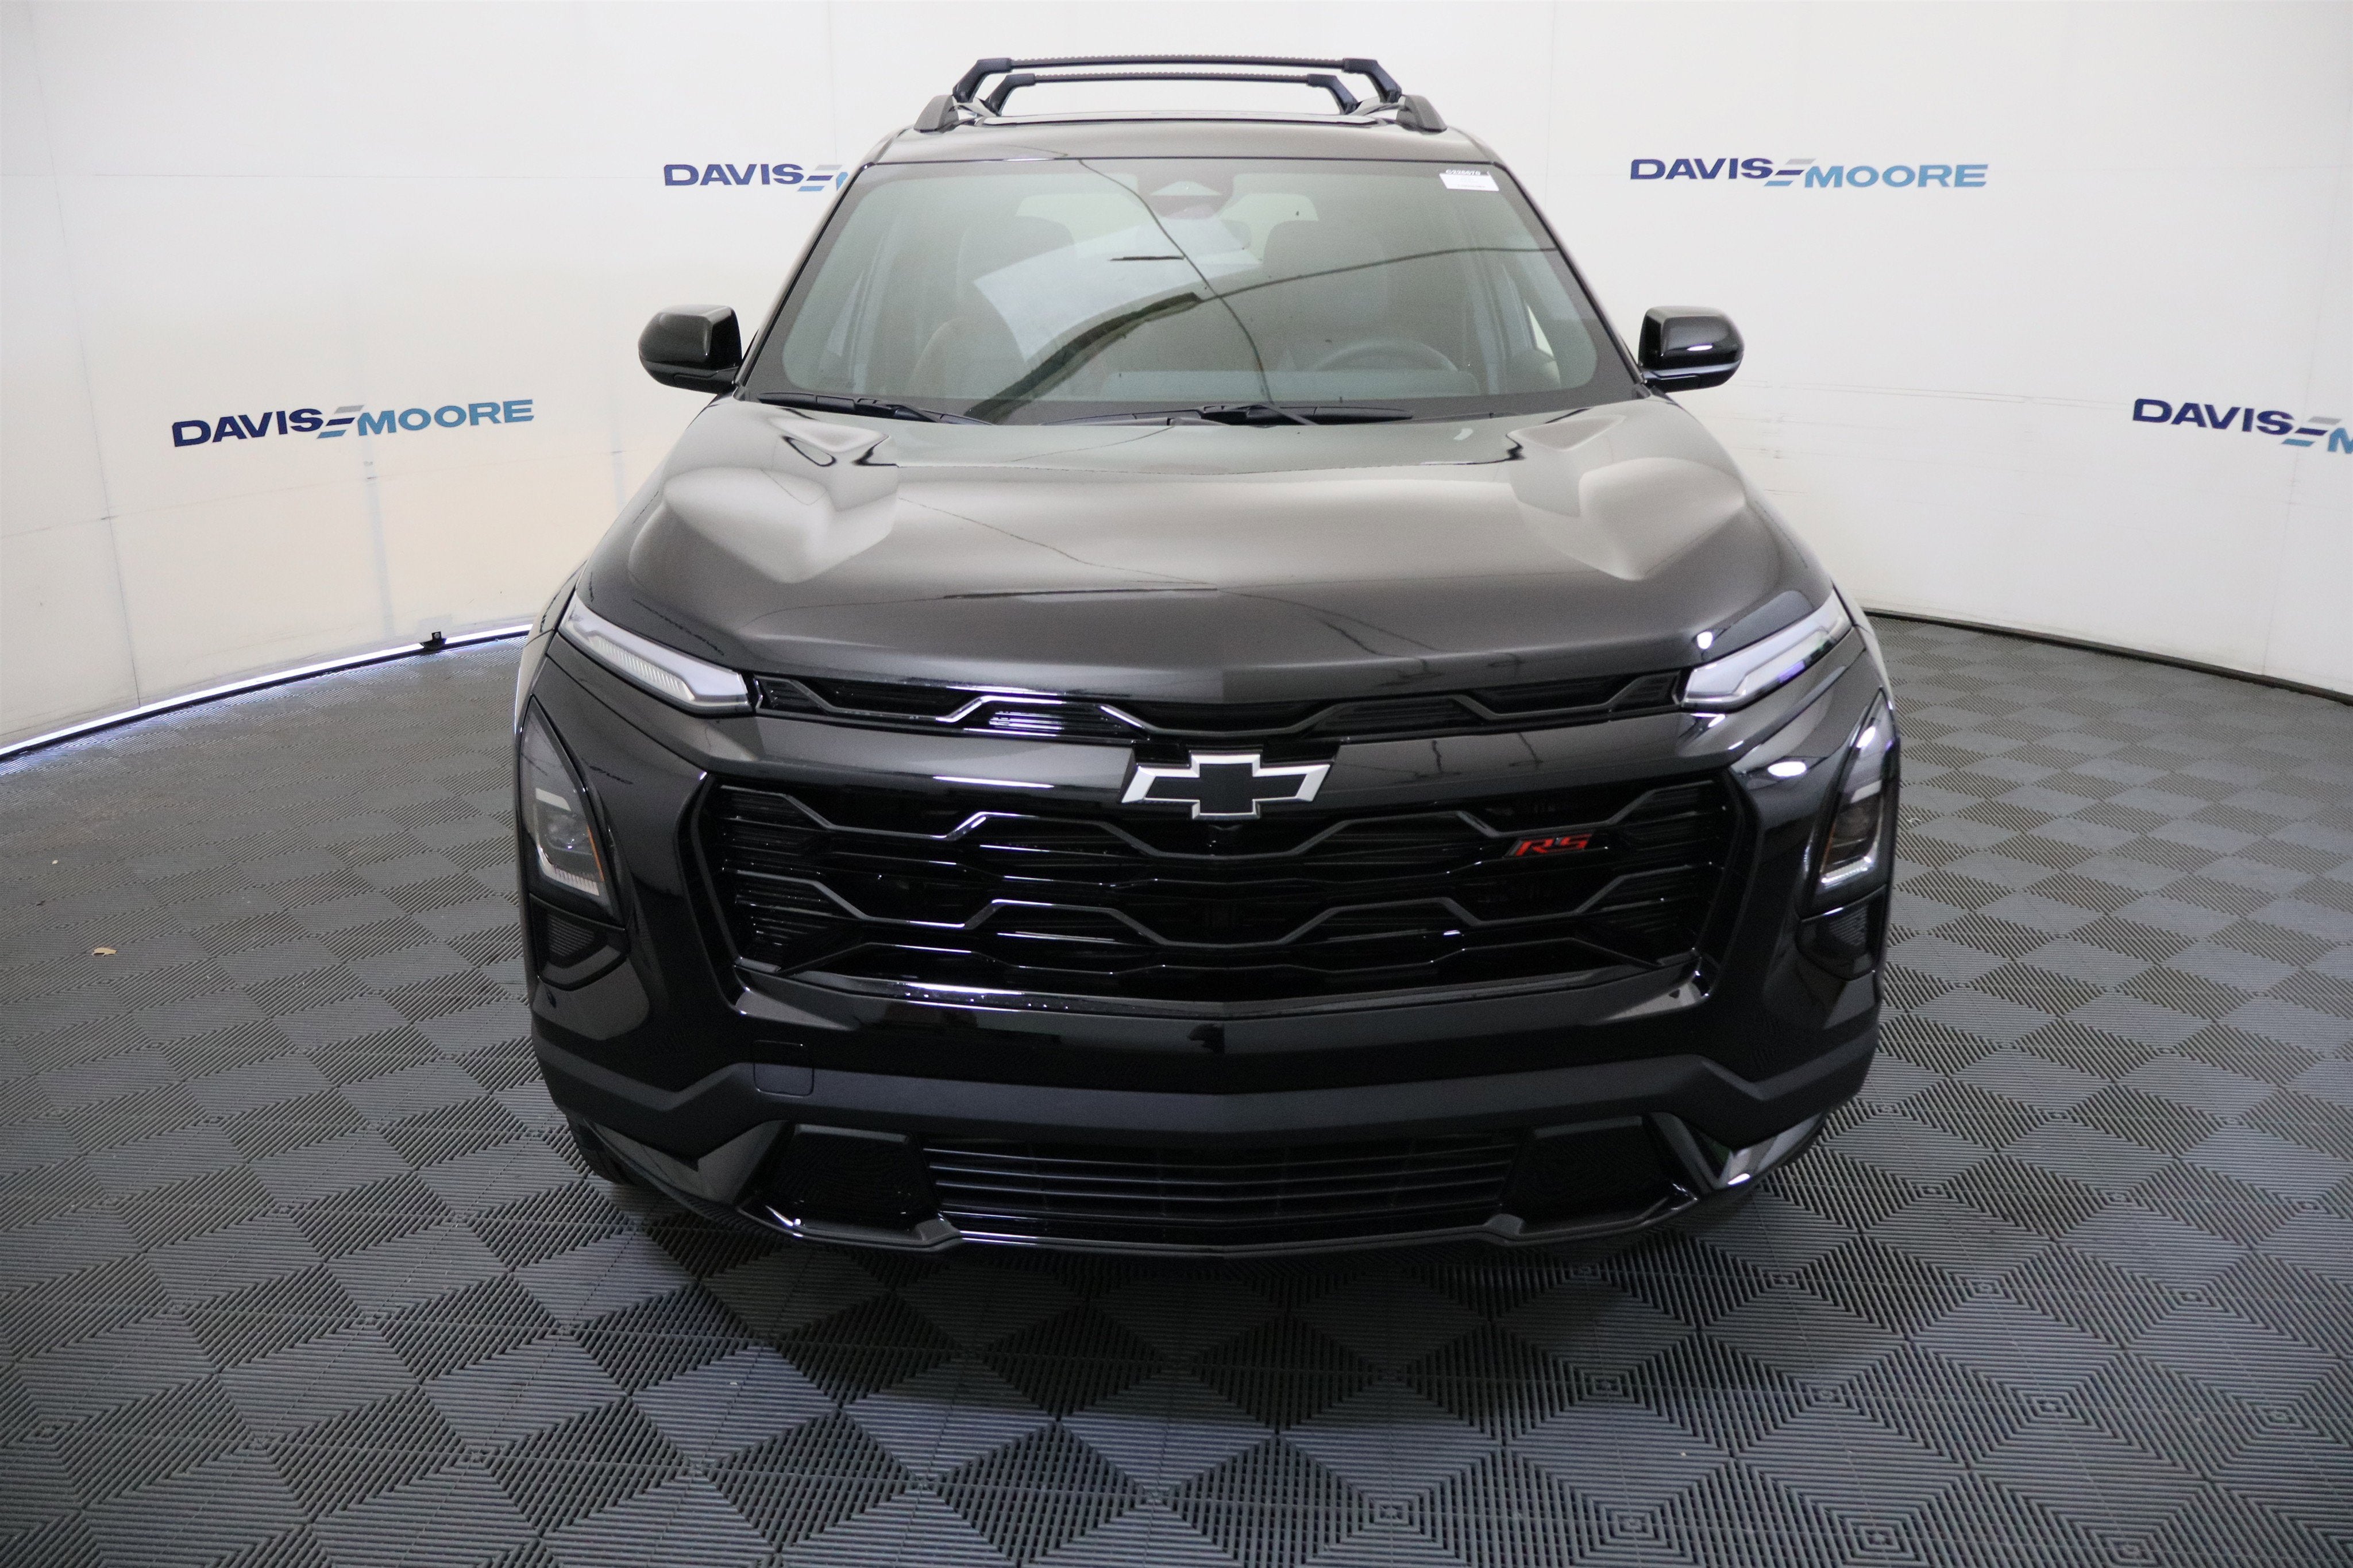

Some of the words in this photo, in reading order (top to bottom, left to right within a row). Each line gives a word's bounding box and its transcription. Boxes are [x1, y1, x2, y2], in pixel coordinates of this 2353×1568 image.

[664, 164, 804, 186] DAVIS
[1630, 158, 1774, 179] DAVIS
[1804, 164, 1989, 188] MOORE
[171, 408, 325, 447] DAVIS
[357, 399, 535, 437] MOORE
[2132, 398, 2294, 435] DAVIS
[1515, 833, 1592, 856] RS
